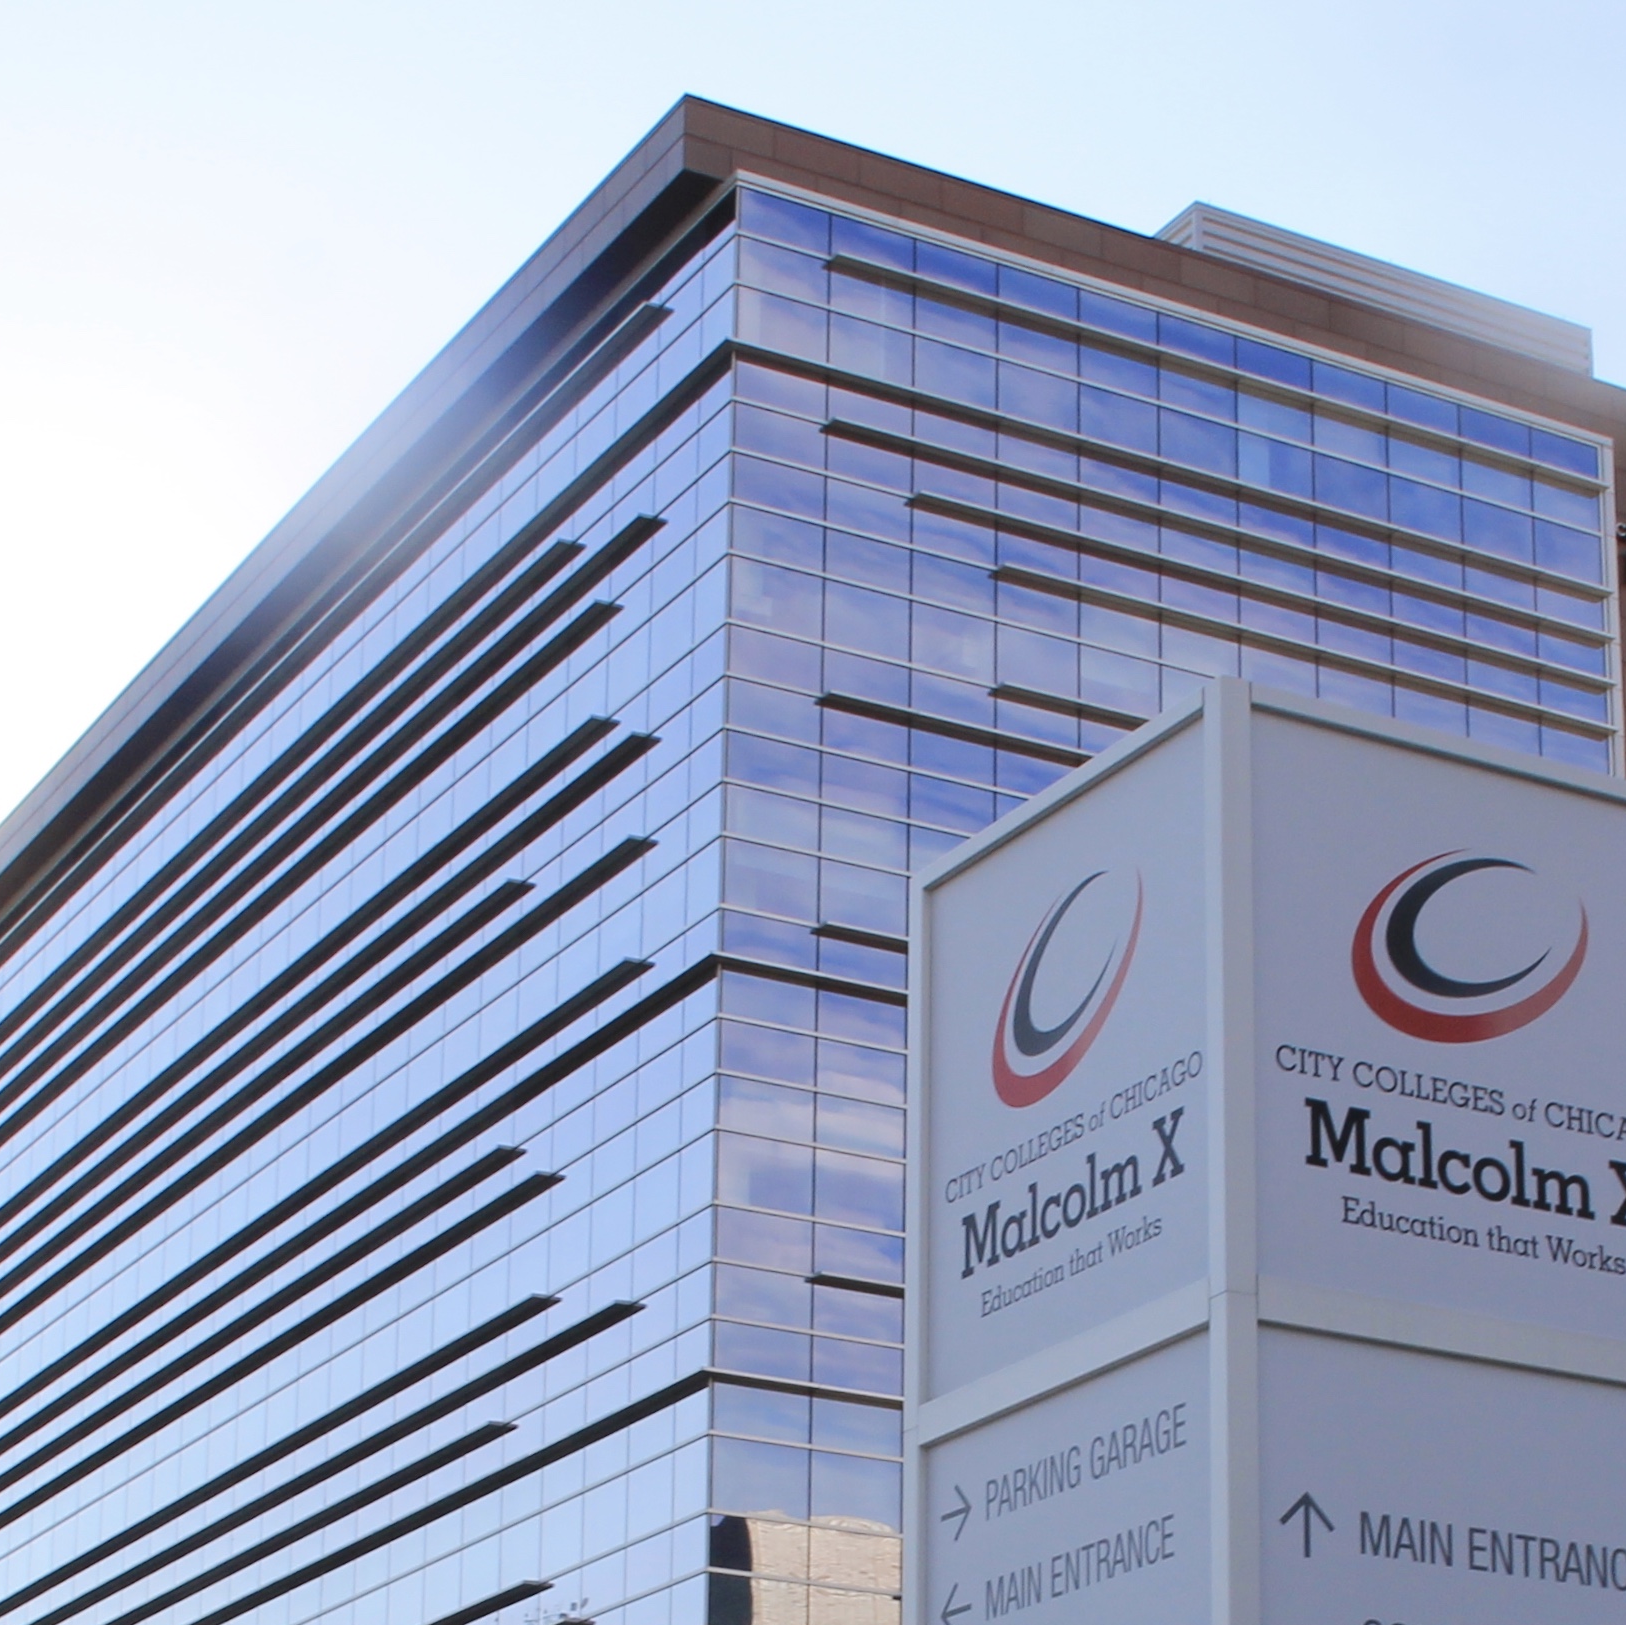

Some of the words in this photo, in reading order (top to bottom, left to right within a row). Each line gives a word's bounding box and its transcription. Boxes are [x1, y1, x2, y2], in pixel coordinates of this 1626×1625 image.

[944, 1162, 987, 1204] CITY
[989, 1112, 1085, 1182] COLLEGES
[1088, 1100, 1107, 1132] of
[1109, 1050, 1203, 1126] CHICAGO
[1275, 1044, 1345, 1082] CITY
[1348, 1060, 1506, 1122] COLLEGES
[1511, 1098, 1538, 1123] of
[958, 1148, 1143, 1284] Malcolm
[1151, 1105, 1185, 1188] X
[1304, 1093, 1596, 1226] Malcolm
[980, 1255, 1065, 1319] Education
[1068, 1240, 1104, 1277] that
[1108, 1215, 1163, 1266] Works
[1340, 1195, 1481, 1248] Education
[1486, 1224, 1540, 1260] that
[985, 1445, 1082, 1521] PARKING
[1089, 1401, 1188, 1481] GARAGE
[985, 1561, 1042, 1622] MAIN
[1050, 1513, 1176, 1599] ENTRANCE
[1359, 1510, 1454, 1568] MAIN
